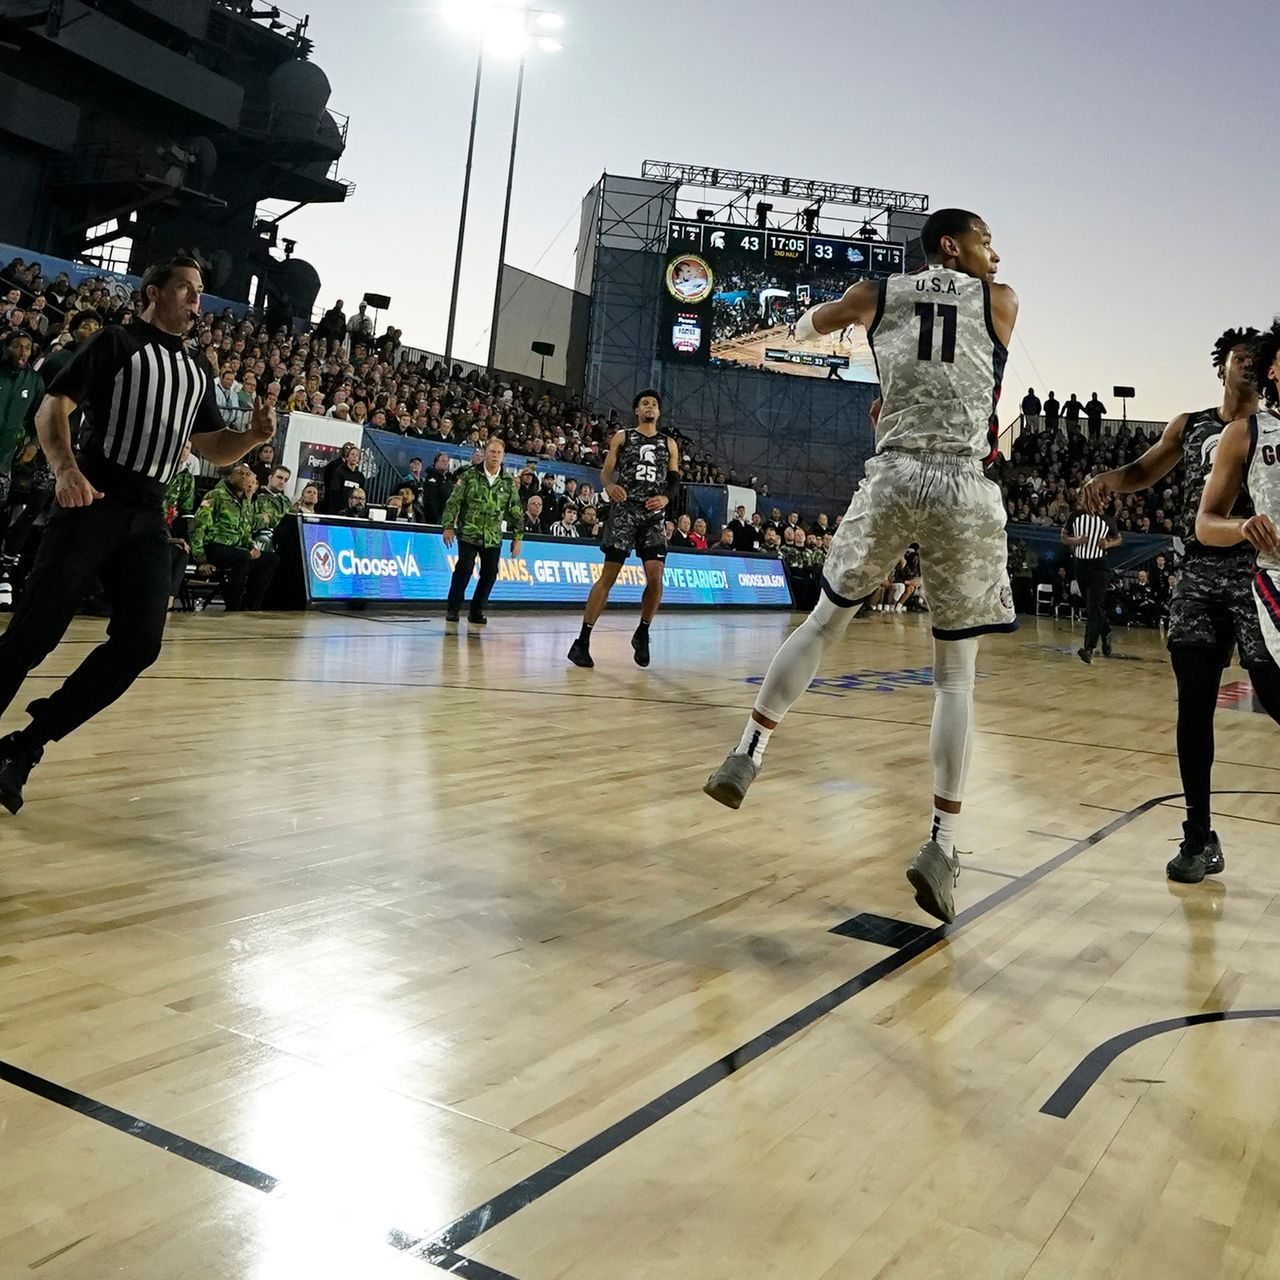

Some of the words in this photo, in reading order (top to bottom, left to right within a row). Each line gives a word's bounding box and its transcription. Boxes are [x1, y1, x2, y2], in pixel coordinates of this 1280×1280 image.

[689, 232, 696, 240] 2
[740, 236, 759, 251] 43
[770, 237, 805, 252] 17:05
[814, 244, 833, 259] 33
[894, 255, 900, 263] 3
[915, 277, 961, 296] U.S.A.
[915, 302, 957, 364] 11
[814, 357, 823, 365] 33
[635, 463, 656, 482] 25
[535, 561, 564, 583] GET
[564, 562, 589, 584] THE
[590, 563, 647, 586] BEEFITS
[661, 567, 687, 587] U'VE
[686, 568, 728, 589] EARNED!
[738, 573, 784, 588] CHOOSEVA.GOV
